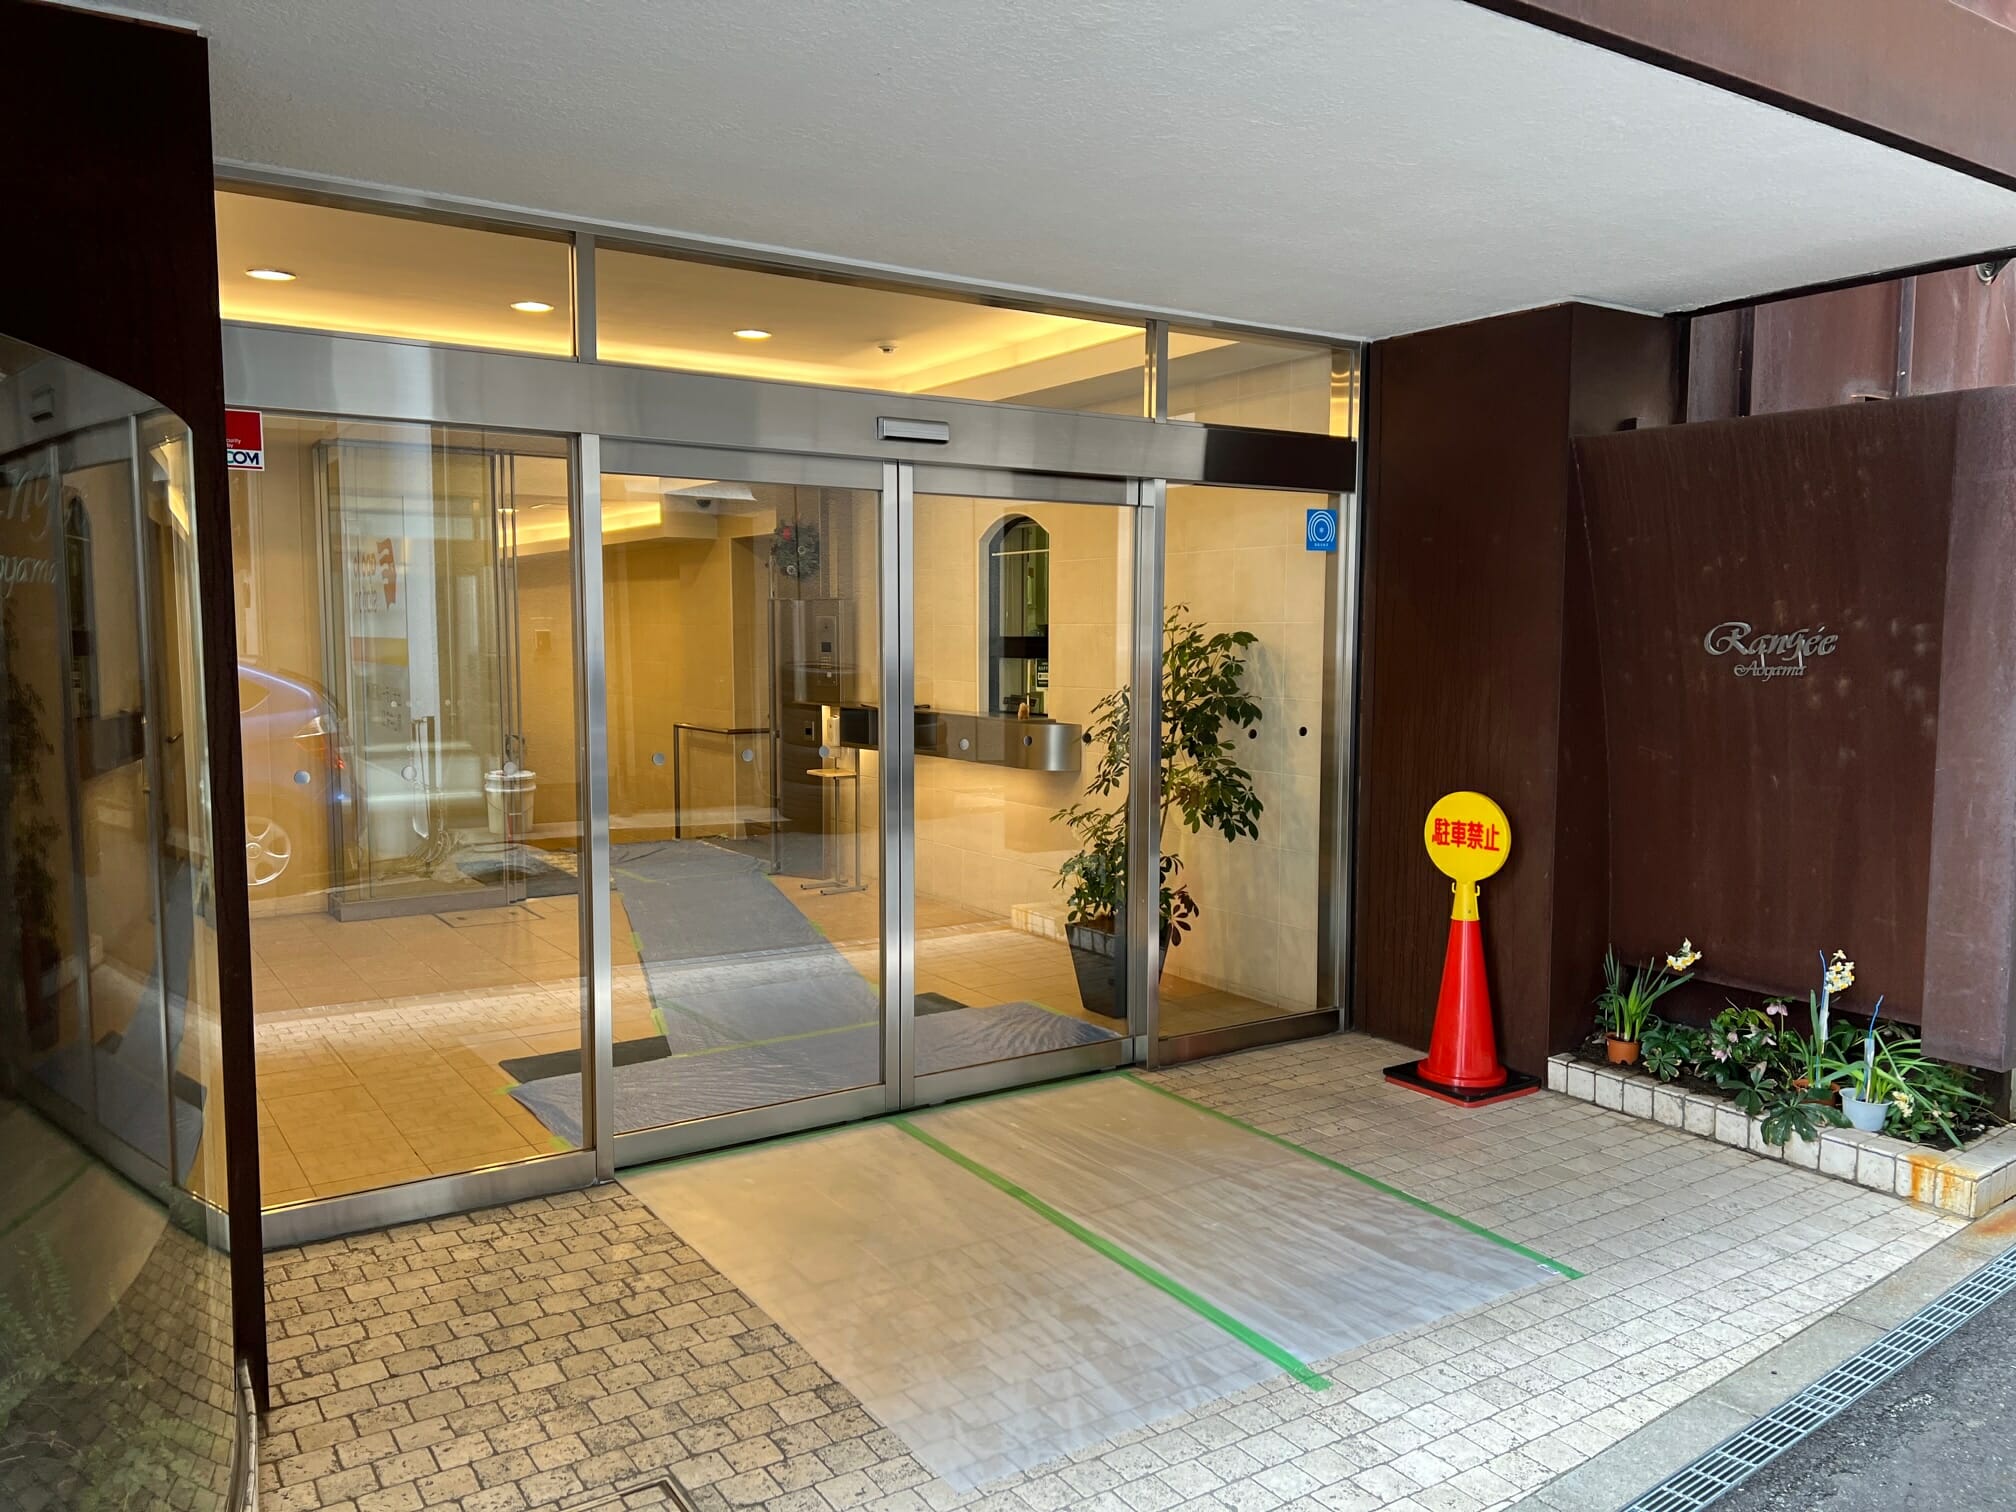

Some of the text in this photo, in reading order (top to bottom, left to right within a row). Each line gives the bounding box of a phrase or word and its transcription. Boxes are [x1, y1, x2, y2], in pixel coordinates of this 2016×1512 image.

[1704, 621, 1839, 662] Rangée
[1432, 817, 1500, 852] 駐車禁止
